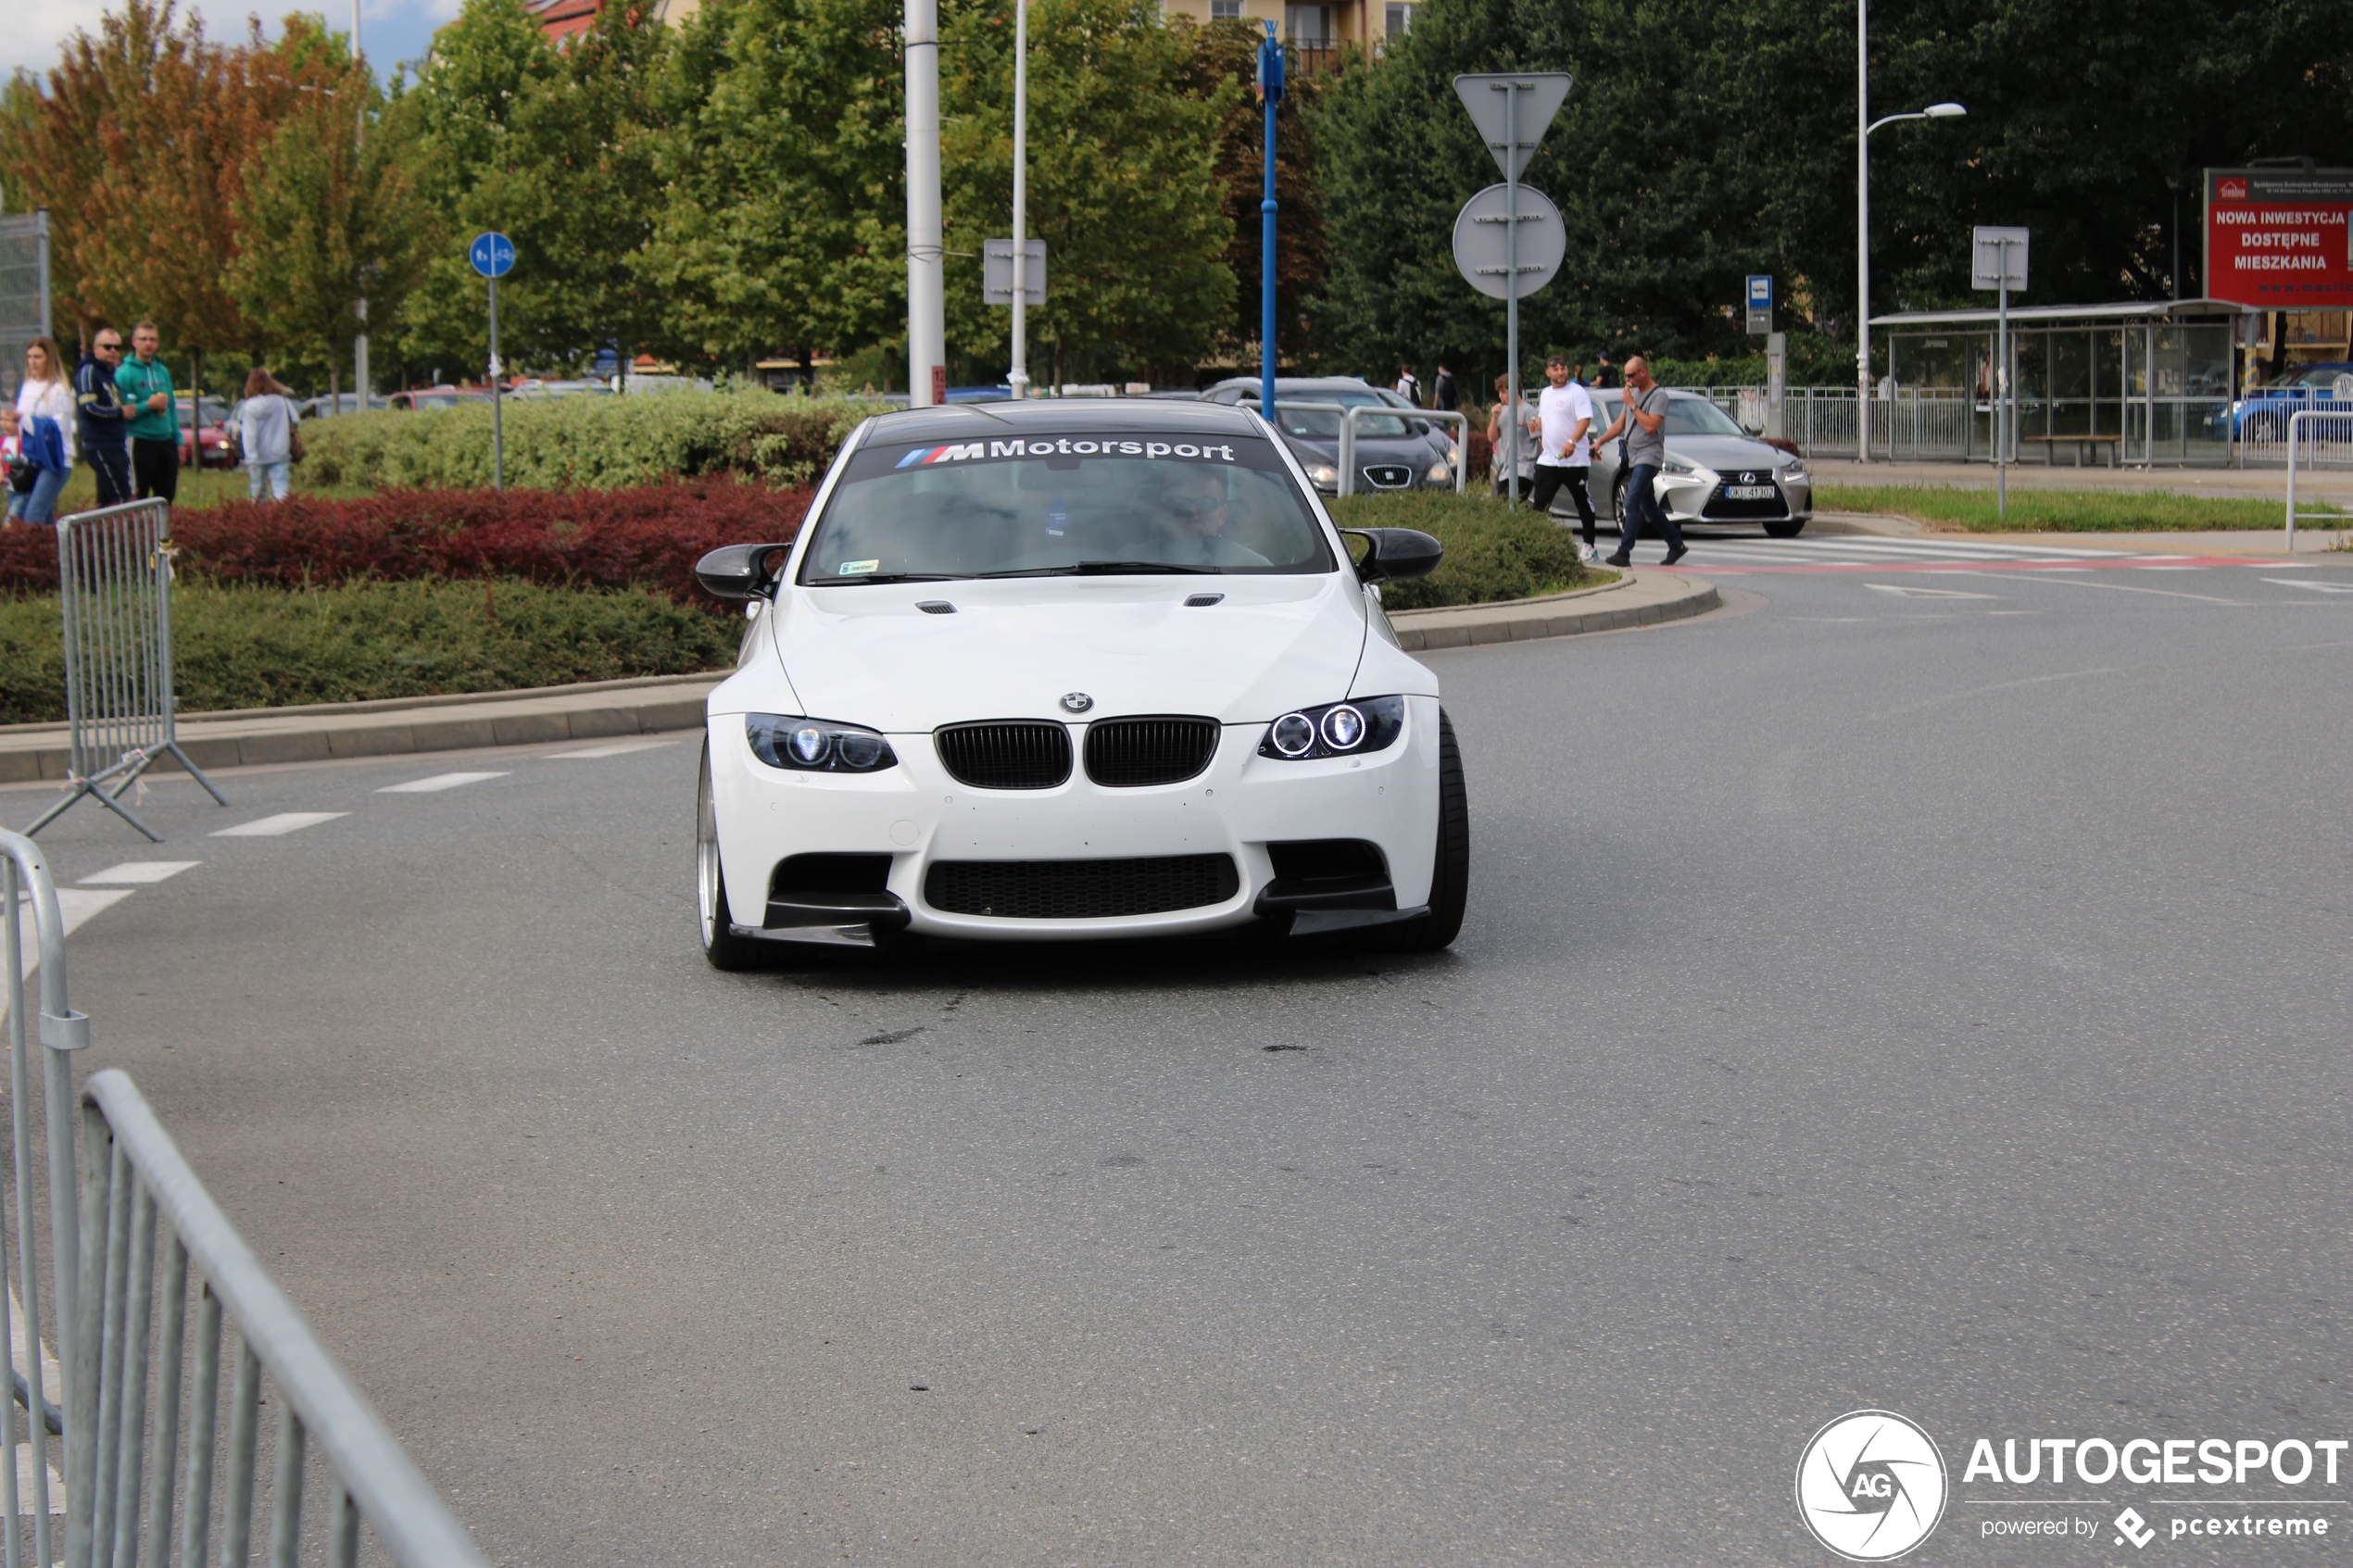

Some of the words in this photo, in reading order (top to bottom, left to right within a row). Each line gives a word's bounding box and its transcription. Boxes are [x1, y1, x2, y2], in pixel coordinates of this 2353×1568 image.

[2216, 211, 2257, 224] NOWA
[2260, 211, 2345, 224] INWESTYCJA
[2241, 232, 2320, 250] DOSTĘPNE
[2234, 256, 2327, 270] MIESZKANIA
[989, 438, 1236, 462] Motorsport
